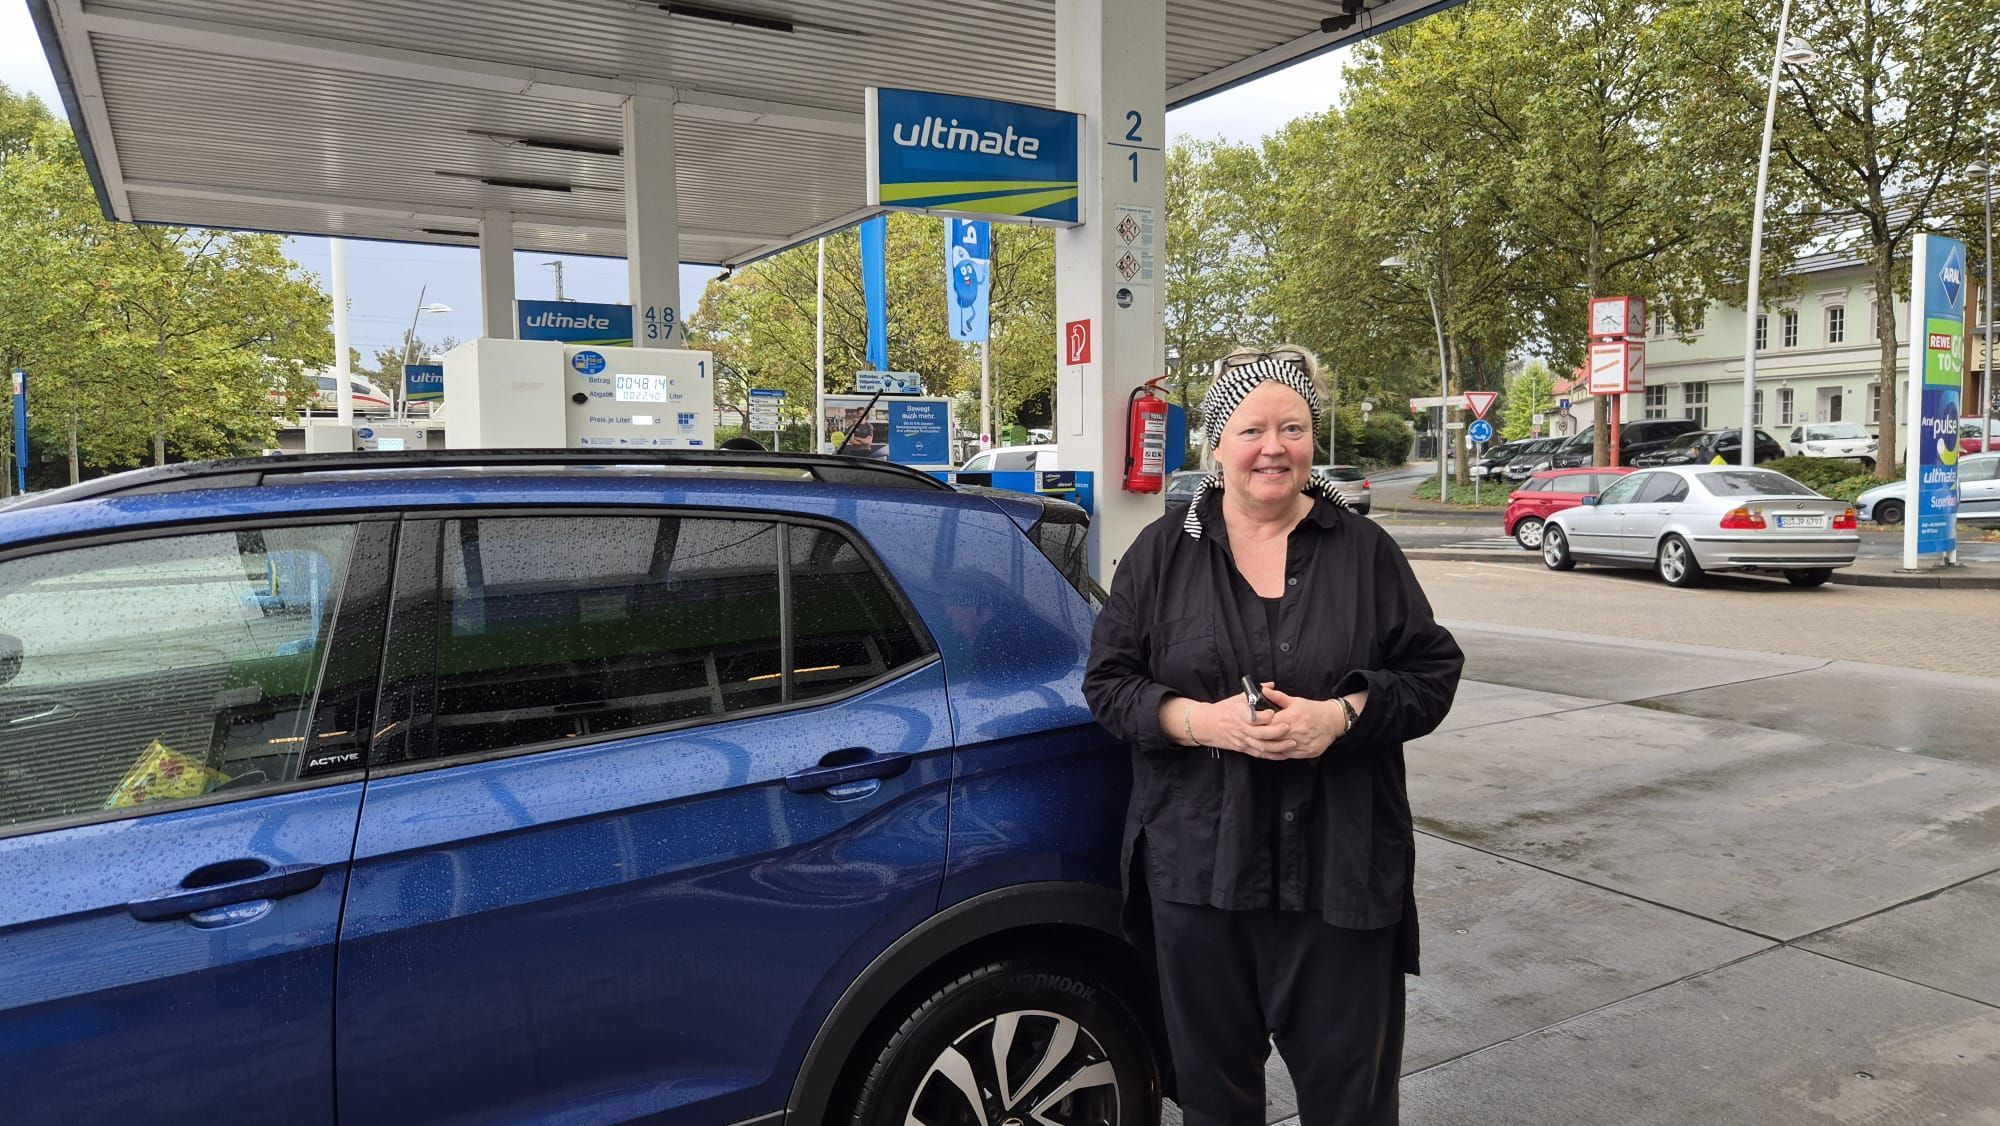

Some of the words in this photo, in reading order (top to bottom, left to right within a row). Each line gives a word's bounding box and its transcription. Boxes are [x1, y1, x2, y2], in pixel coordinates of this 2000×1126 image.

[1126, 110, 1142, 142] 2
[893, 116, 1040, 160] ultimate
[1128, 151, 1138, 183] 1
[1943, 267, 1960, 284] ARAL
[526, 312, 610, 330] ultimate
[645, 306, 656, 322] 4
[663, 306, 674, 322] 8
[647, 323, 658, 339] 3
[662, 324, 673, 340] 7
[1930, 335, 1951, 349] REWE
[698, 360, 705, 378] 1
[1938, 353, 1951, 372] TO
[588, 376, 611, 385] Betrag
[907, 405, 930, 413] Bewegt
[918, 412, 936, 420] mehr.
[607, 416, 614, 424] je
[1921, 416, 1934, 426] Aral
[1933, 414, 1957, 439] pulse
[416, 430, 423, 439] 3
[310, 752, 360, 767] ACTIVE
